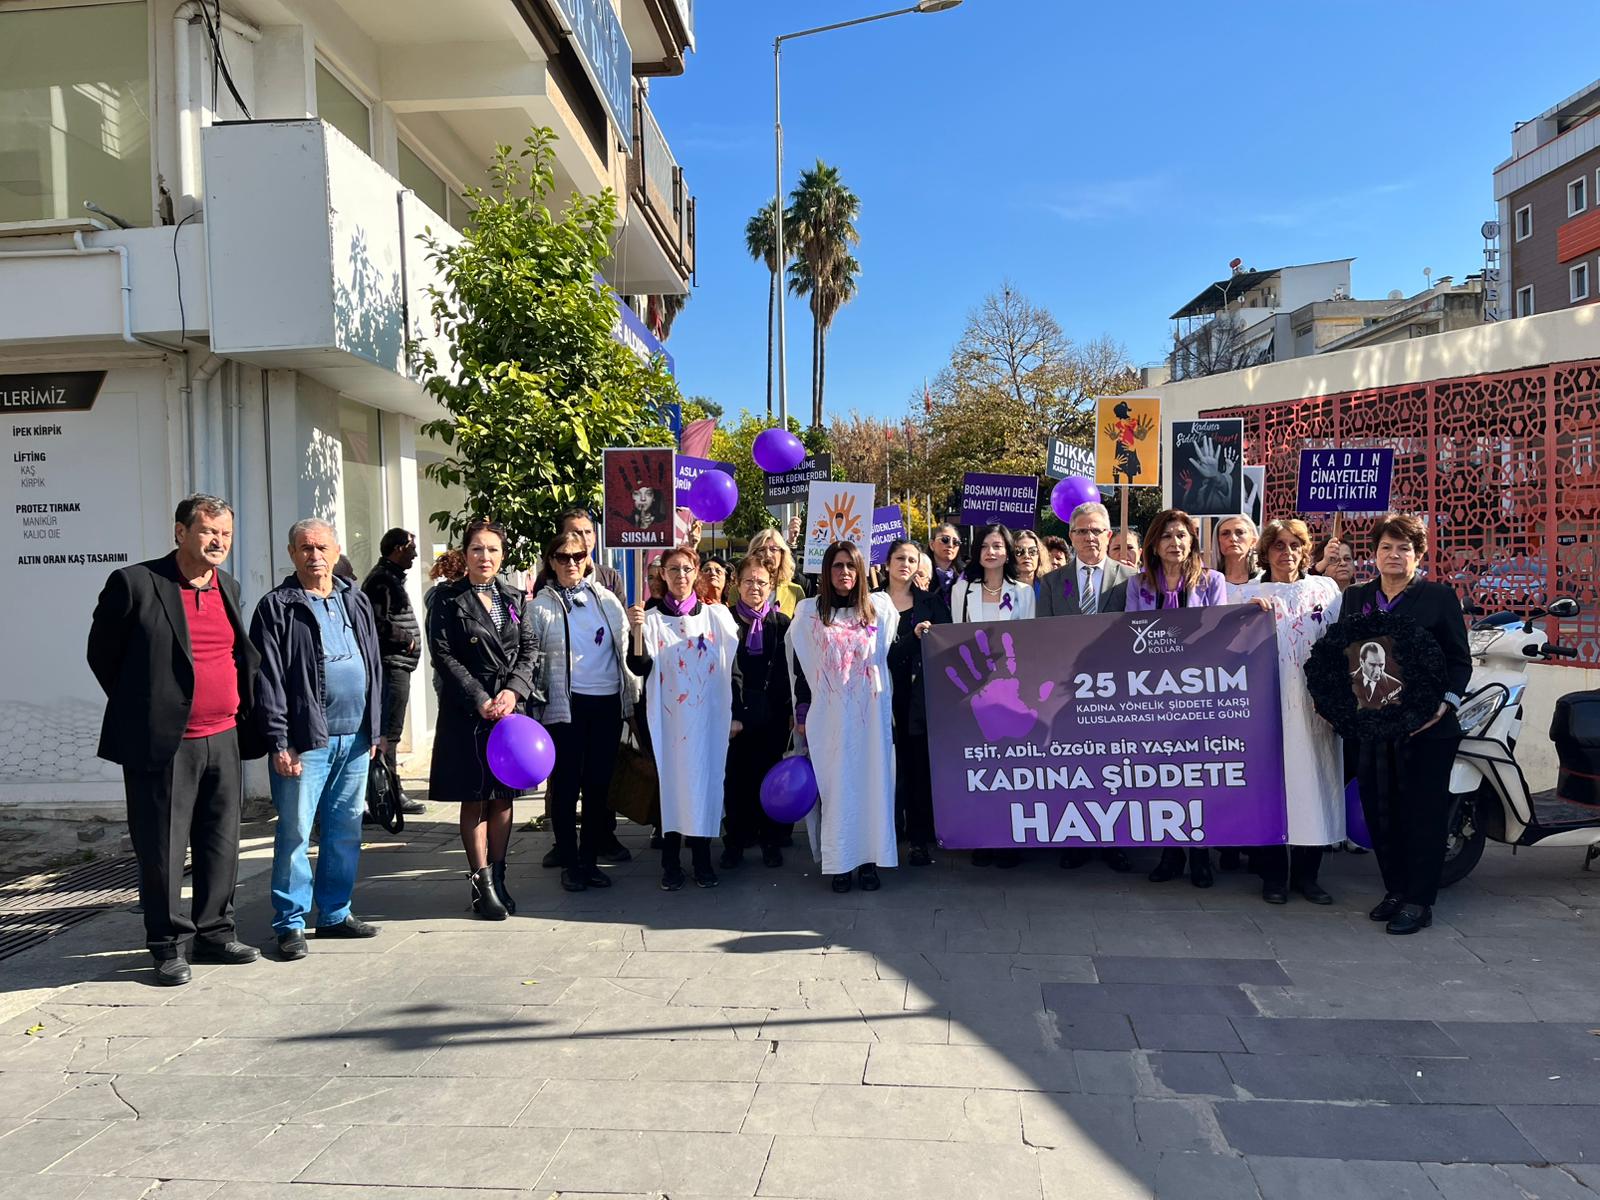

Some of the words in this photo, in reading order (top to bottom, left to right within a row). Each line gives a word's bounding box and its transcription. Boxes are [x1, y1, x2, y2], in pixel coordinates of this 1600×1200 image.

[12, 425, 32, 437] İPEK
[33, 424, 62, 436] KİRPİK
[13, 451, 46, 462] LİFTİNG
[1053, 455, 1068, 467] BU
[1312, 453, 1380, 467] KADIN
[768, 475, 785, 485] TERK
[786, 470, 828, 483] EDENLERDEN
[1310, 467, 1379, 483] CİNAYETLERİ
[768, 486, 790, 497] HESAP
[964, 484, 1010, 497] BOŞANMAYI
[1309, 484, 1377, 500] POLİTİKTİR
[15, 503, 48, 513] PROTEZ
[49, 502, 81, 513] TIRNAK
[963, 497, 998, 511] CİNAYETİ
[999, 501, 1035, 514] ENGELLE
[621, 531, 657, 543] SUSMA
[18, 556, 41, 565] ALTIN
[43, 555, 66, 564] ORAN
[68, 554, 85, 565] KAŞ
[87, 553, 128, 563] TASARIMI
[1147, 630, 1166, 638] CHP
[1148, 637, 1177, 646] KADIN
[1149, 645, 1184, 654] KOLLARI
[1073, 671, 1117, 699] 25
[1127, 665, 1248, 697] KASIM
[1076, 703, 1116, 713] KADINA
[1119, 700, 1165, 711] YÖNELİK
[1168, 698, 1213, 711] ŞİDDETE
[1217, 697, 1250, 708] KARŞI
[1077, 713, 1155, 725] ULUSLARARASI
[1157, 710, 1216, 722] MÜCADELE
[1217, 708, 1251, 719] GÜNÜ
[964, 743, 1001, 762] EŞİT,
[1004, 742, 1046, 758] ADİL,
[1049, 740, 1107, 756] ÖZGÜR
[1110, 738, 1138, 755] BİR
[1141, 739, 1199, 756] YAŞAM
[1204, 735, 1246, 755] İÇİN;
[966, 765, 1095, 792] KADINA
[1101, 758, 1247, 796] ŞİDDETE
[1010, 799, 1206, 843] HAYIR!
